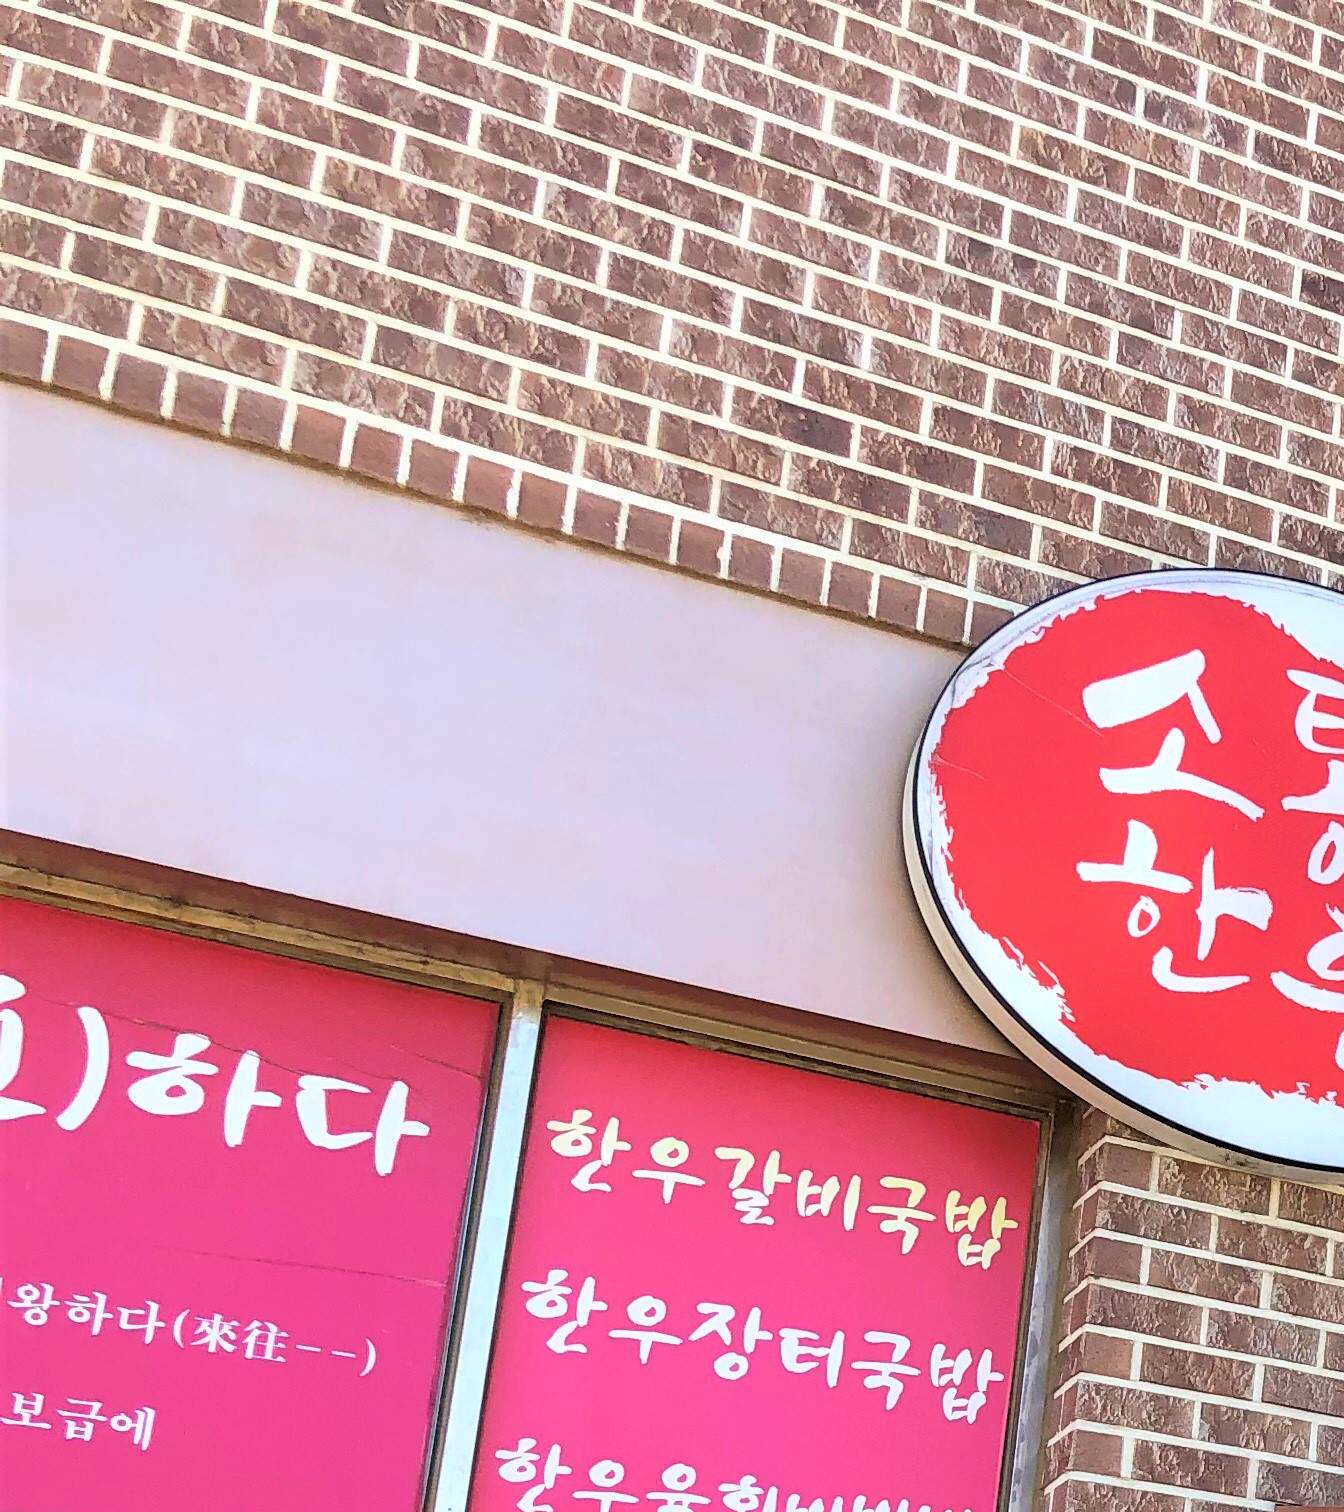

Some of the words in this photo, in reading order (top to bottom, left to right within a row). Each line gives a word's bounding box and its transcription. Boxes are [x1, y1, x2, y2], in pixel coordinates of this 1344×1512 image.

[546, 1107, 1019, 1270] 한우갈비국밥
[0, 1277, 379, 1378] 왕하다(來往--)
[520, 1266, 1005, 1424] 한우장터국밥
